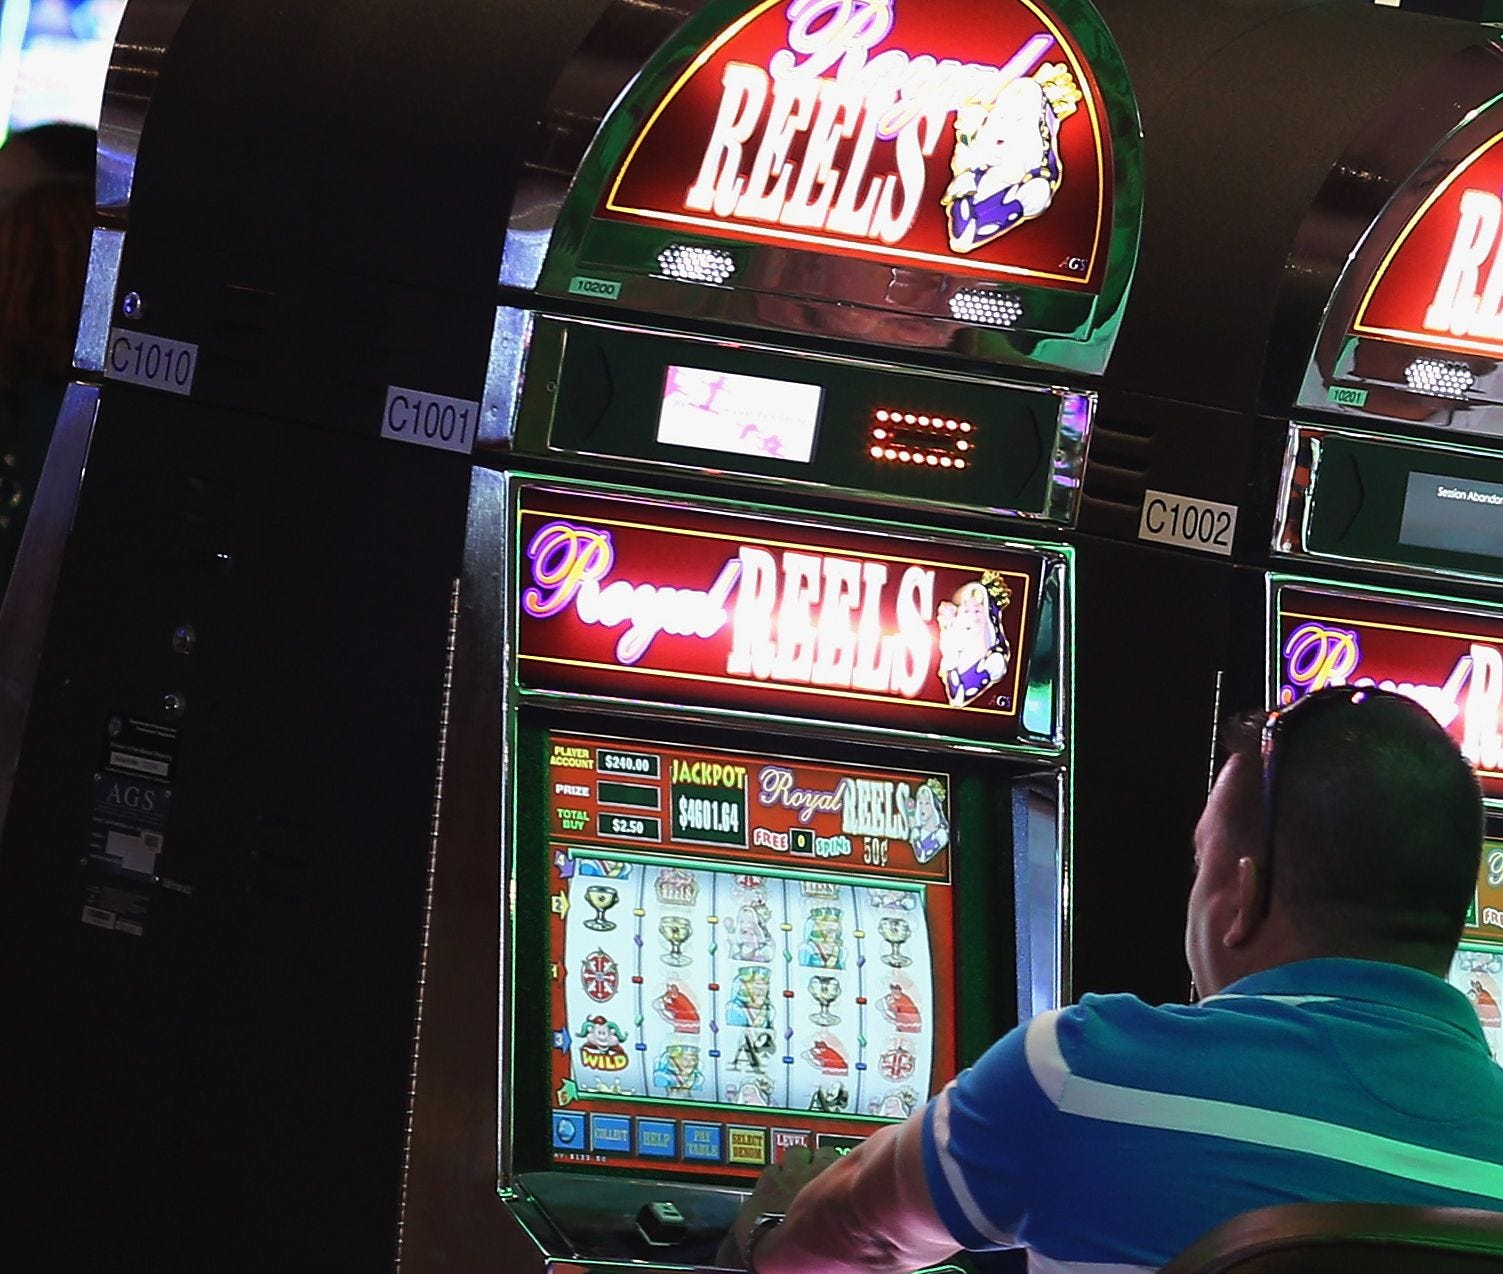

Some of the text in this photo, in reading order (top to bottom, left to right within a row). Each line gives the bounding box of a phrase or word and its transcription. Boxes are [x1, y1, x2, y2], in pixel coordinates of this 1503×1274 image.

[768, 0, 1055, 141] Royal
[685, 61, 950, 243] REELS
[577, 281, 615, 295] 10200
[111, 338, 191, 386] C1010
[1334, 389, 1361, 404] 10201
[388, 395, 470, 443] C1001
[1437, 487, 1466, 500] Session
[1145, 498, 1232, 547] C1002
[522, 520, 935, 698] Royal REELS
[554, 746, 590, 759] PLAYER
[550, 755, 594, 769] ACCOUNT
[605, 755, 649, 772] $240.00
[672, 759, 746, 789] JACKPOT
[106, 783, 155, 811] AGS
[555, 784, 590, 797] PRIZE
[759, 767, 911, 840] Royal REELS
[556, 808, 590, 821] TOTAL
[562, 819, 585, 831] BUY
[612, 819, 644, 834] $2.50
[754, 828, 788, 851] FREE
[582, 1049, 628, 1071] WILD
[731, 1134, 763, 1148] SELECT
[776, 1133, 807, 1147] LEVEL
